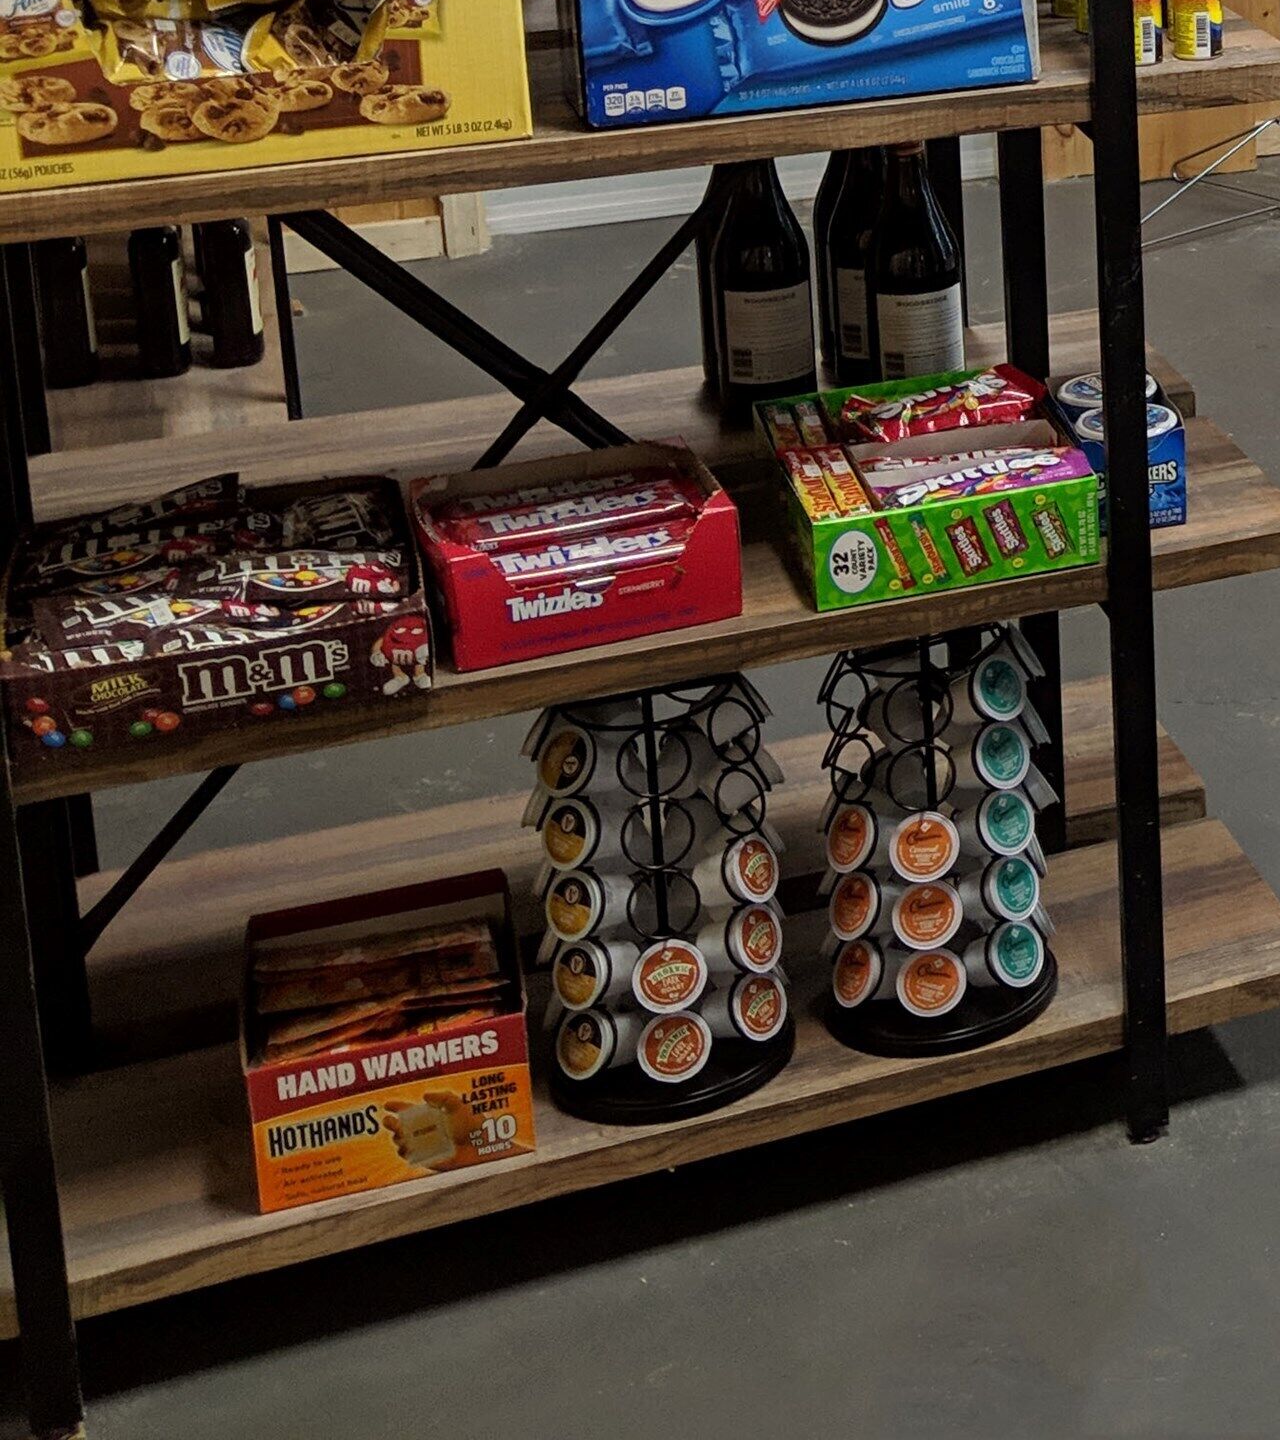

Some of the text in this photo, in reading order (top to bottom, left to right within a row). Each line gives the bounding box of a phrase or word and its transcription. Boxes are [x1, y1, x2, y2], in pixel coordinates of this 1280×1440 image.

[416, 121, 482, 138] NET WT 5 LB 3 OZ
[35, 163, 74, 177] POUCHES
[899, 452, 1061, 507] Skittles
[478, 489, 658, 534] Twizzlers
[990, 507, 1020, 550] Skittles
[832, 549, 850, 578] 32
[850, 548, 858, 578] COUNT
[858, 539, 867, 581] VARIETY
[867, 545, 876, 572] PACK
[618, 579, 665, 595] STRAWBERRY
[505, 587, 604, 623] Twizzlers
[90, 672, 143, 692] MILK
[90, 680, 149, 704] CHOCOLATE
[276, 1030, 500, 1101] HAND WARMERS
[471, 1071, 506, 1089] LONG
[462, 1083, 518, 1105] LASTING
[472, 1097, 510, 1115] HEAT!
[267, 1104, 380, 1158] HOTHANDS
[469, 1129, 482, 1140] UP
[482, 1114, 517, 1142] 10
[470, 1137, 483, 1147] TO
[477, 1140, 512, 1157] HOURS
